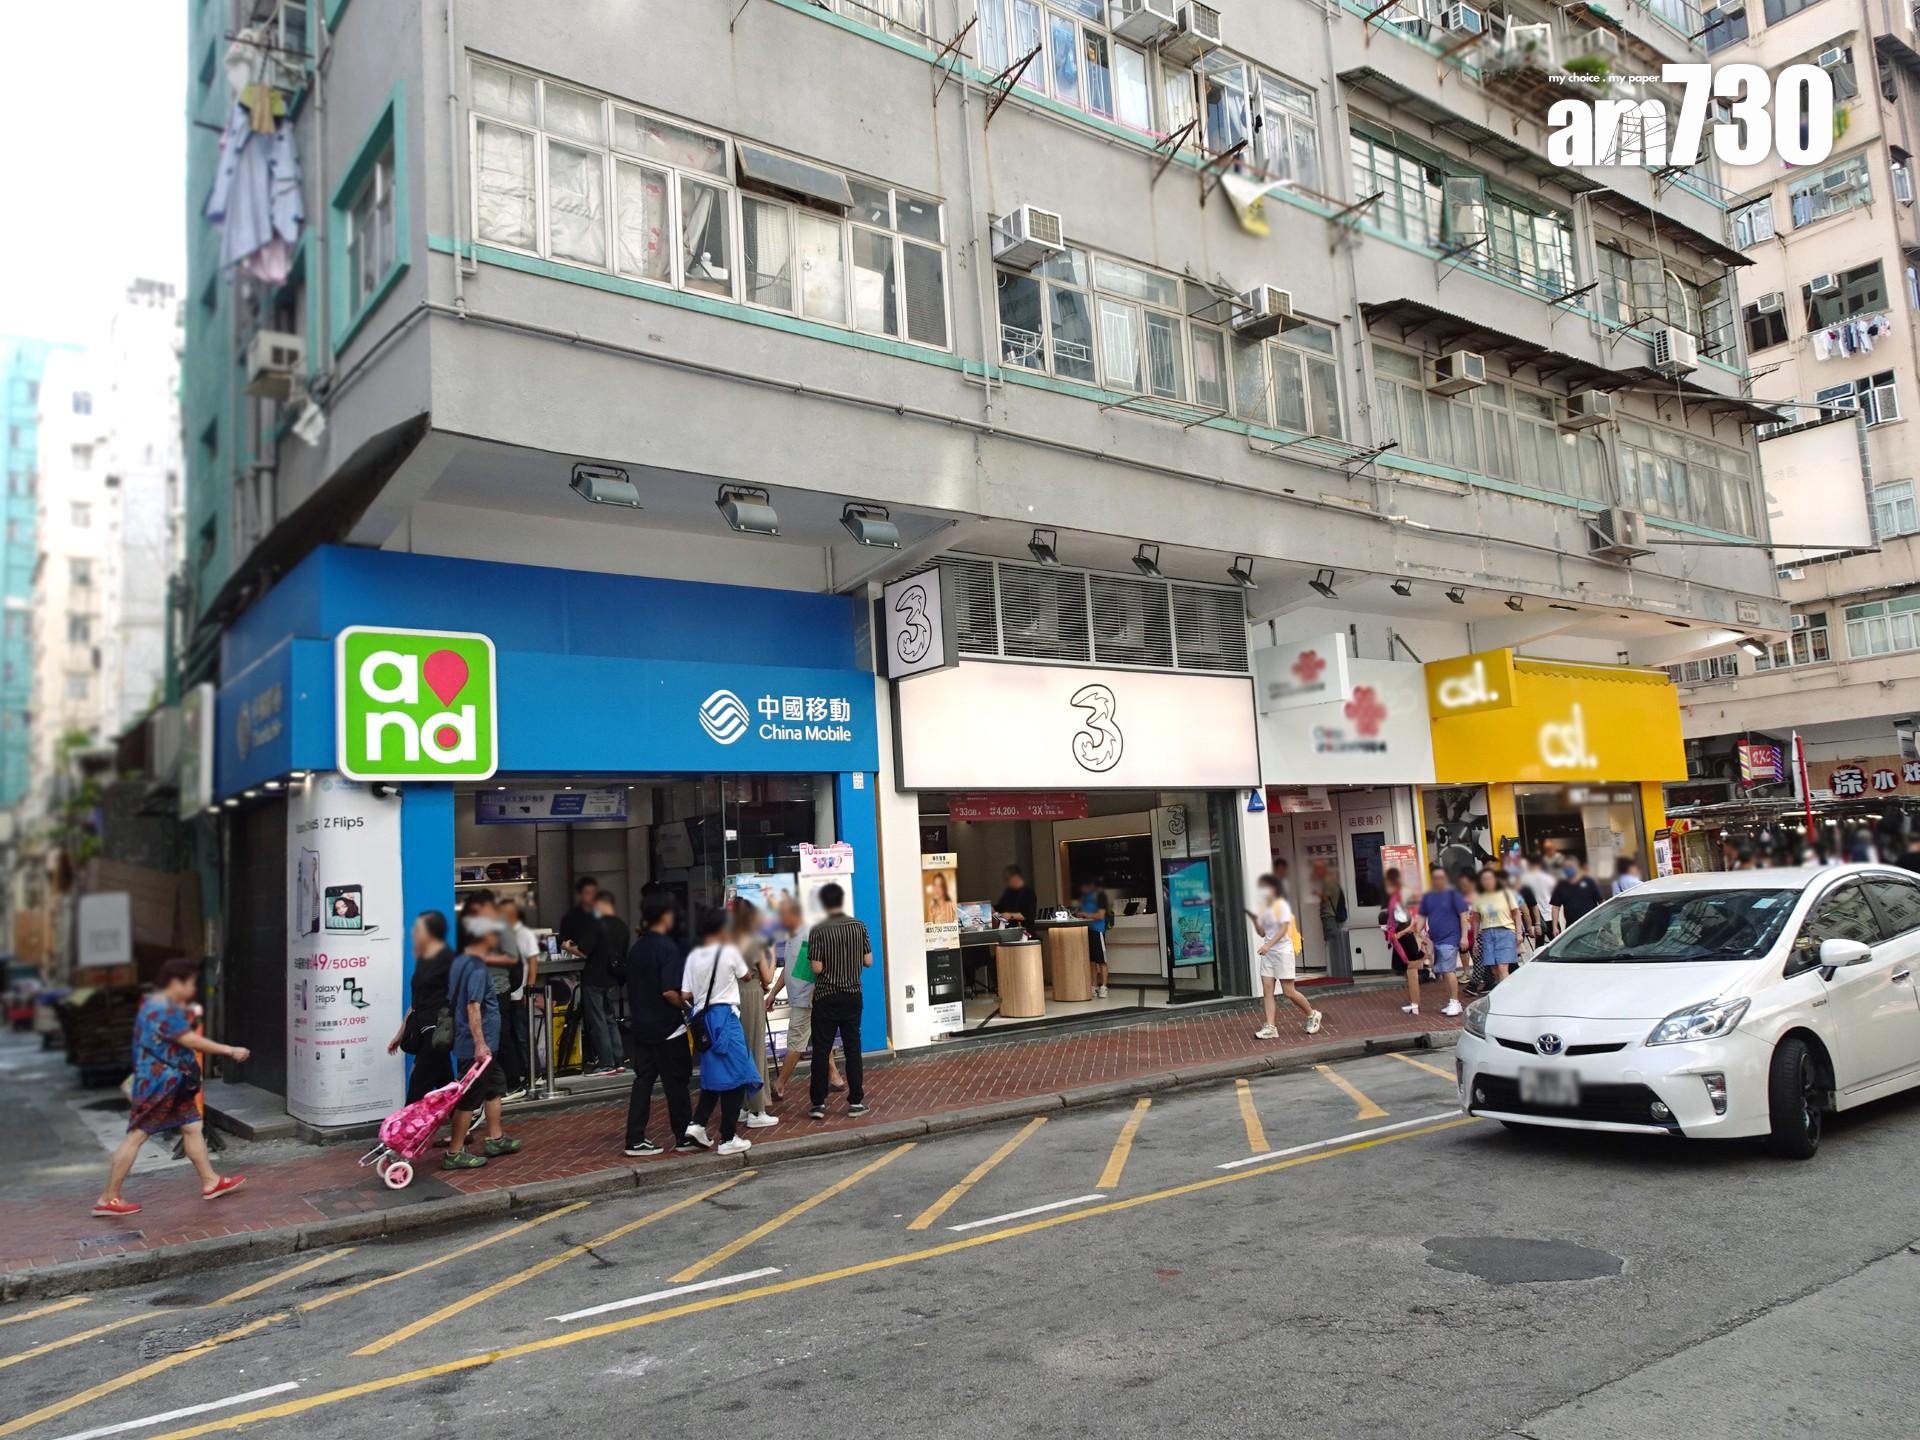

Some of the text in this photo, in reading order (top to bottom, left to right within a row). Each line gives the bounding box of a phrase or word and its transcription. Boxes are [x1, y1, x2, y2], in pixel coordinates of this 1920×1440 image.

[895, 584, 932, 664] 3
[758, 694, 851, 722] 中國移動
[759, 724, 852, 742] China Mobile
[1070, 683, 1123, 773] 3
[333, 817, 364, 830] Flip5
